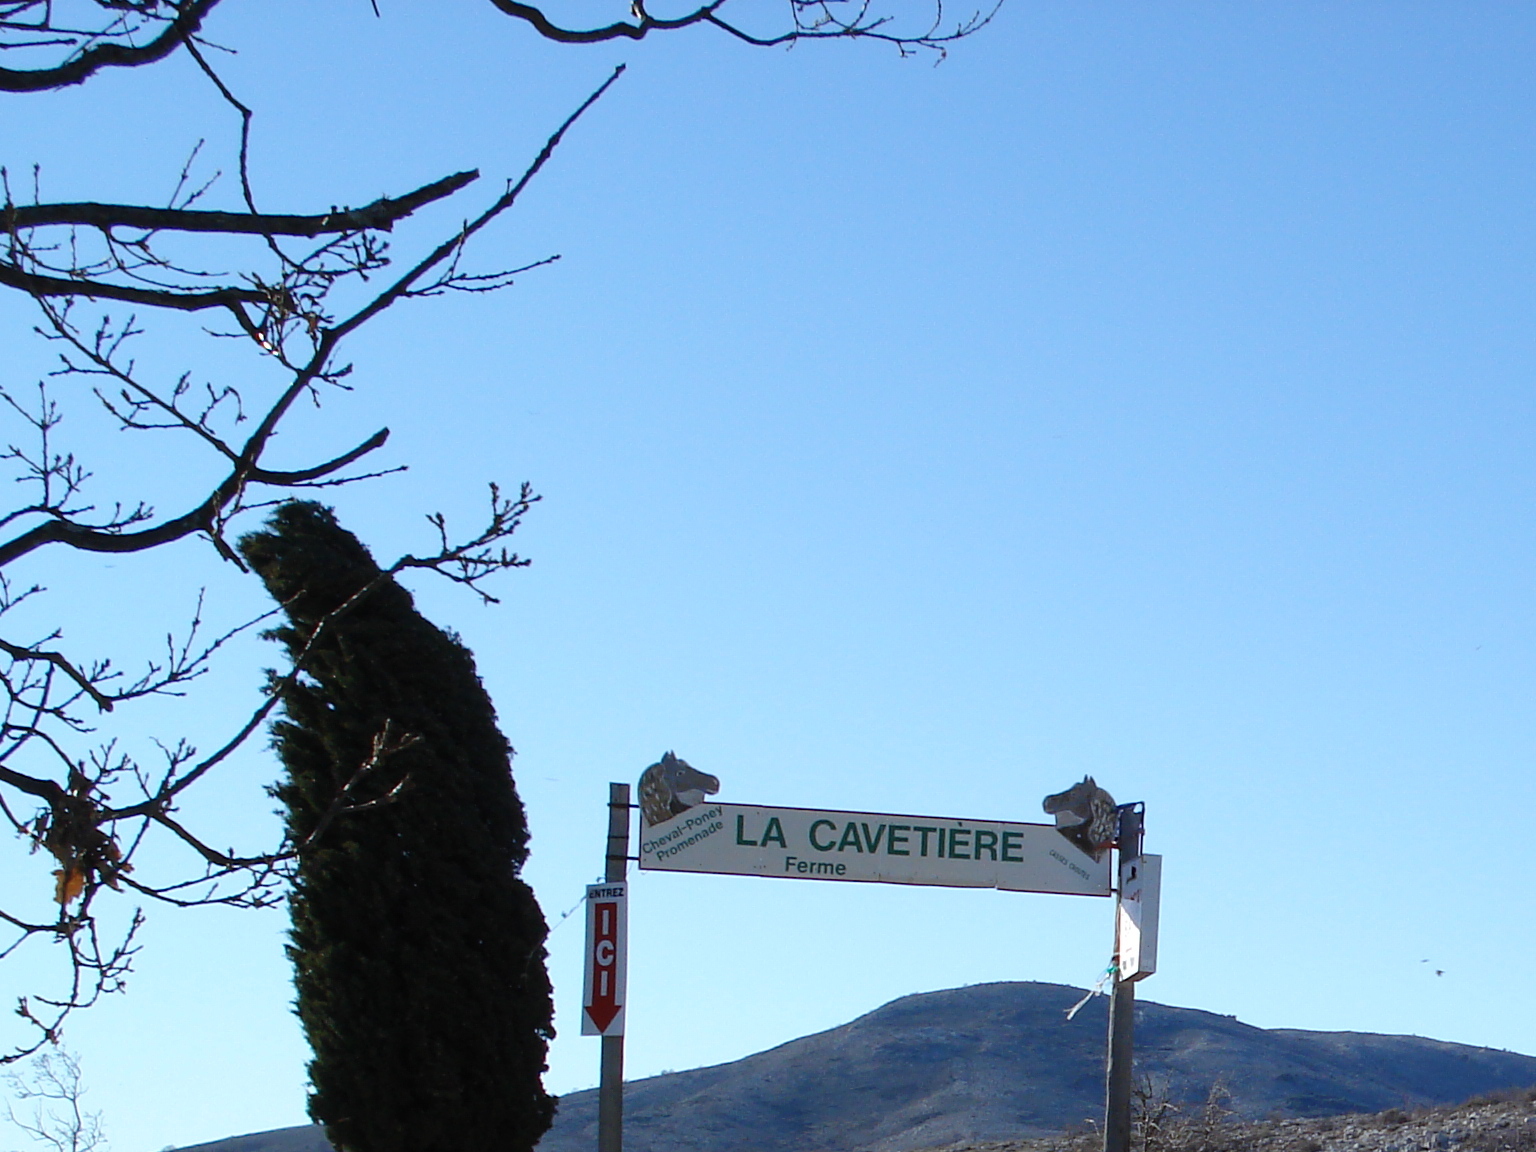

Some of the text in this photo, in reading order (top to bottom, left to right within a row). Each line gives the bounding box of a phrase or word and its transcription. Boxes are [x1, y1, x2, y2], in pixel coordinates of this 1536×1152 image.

[642, 805, 723, 854] Cheval-Poney
[656, 820, 724, 861] Promenade
[736, 814, 1025, 863] LA CAVETIÈRE
[785, 856, 847, 876] Ferme
[589, 887, 625, 899] ENTREZ
[596, 909, 615, 997] ICI
